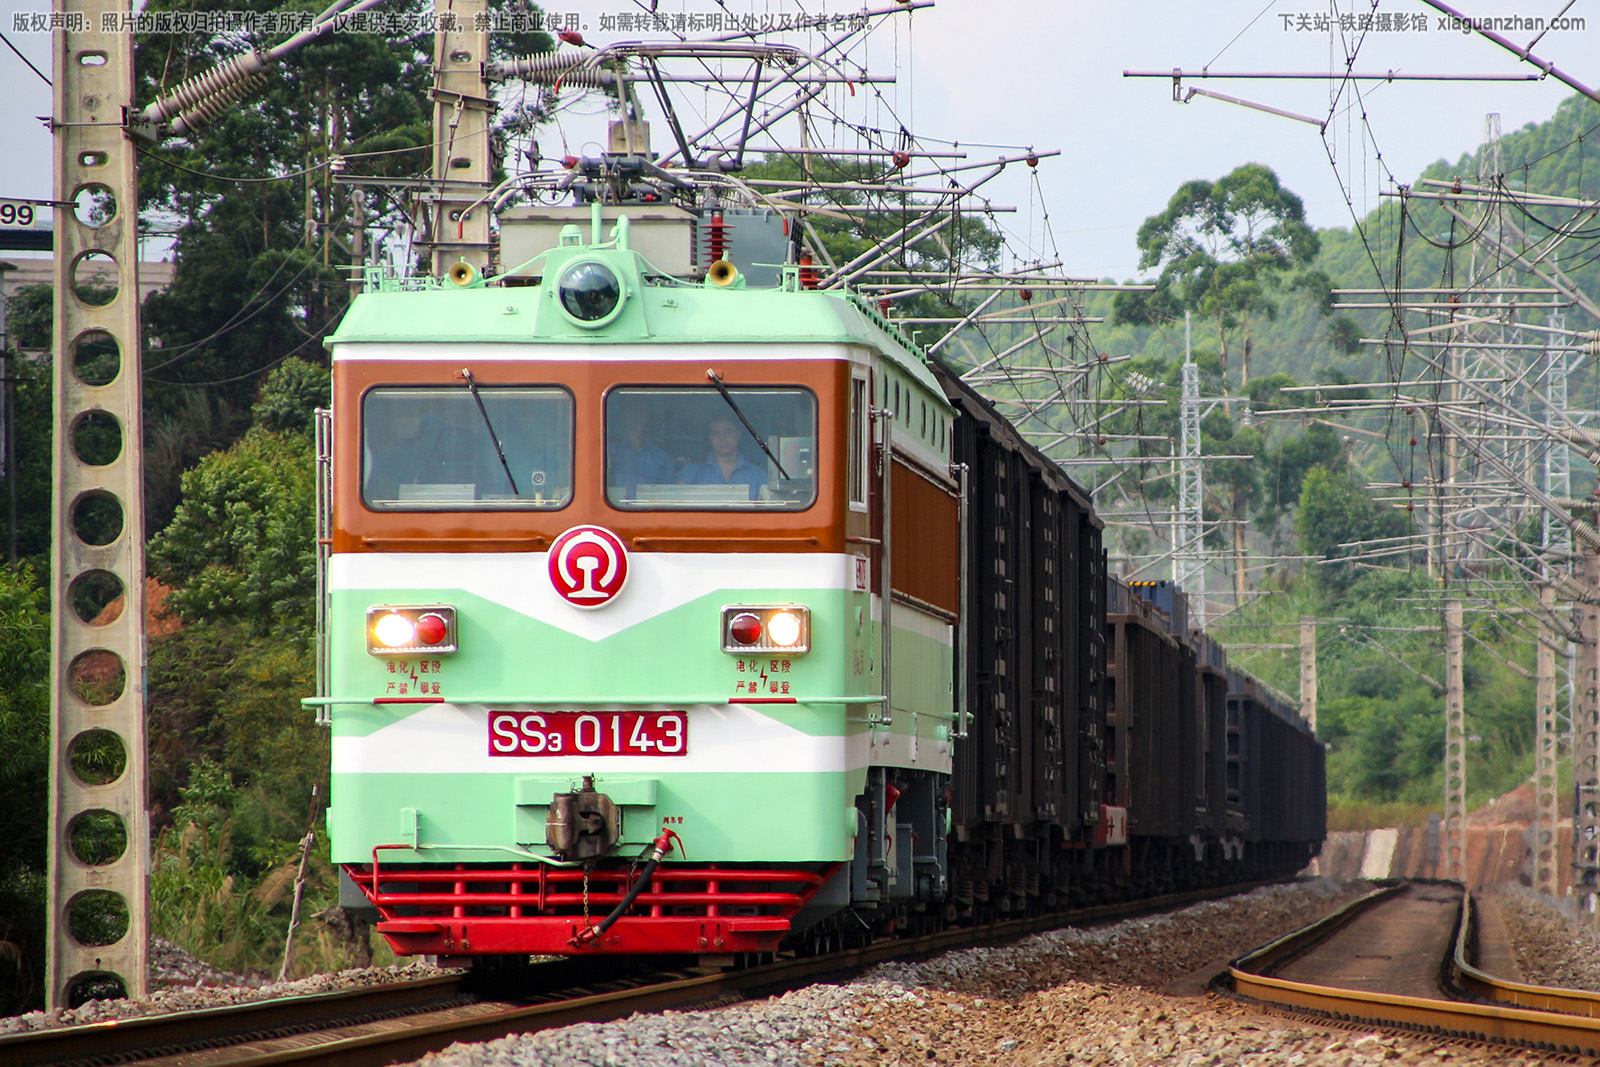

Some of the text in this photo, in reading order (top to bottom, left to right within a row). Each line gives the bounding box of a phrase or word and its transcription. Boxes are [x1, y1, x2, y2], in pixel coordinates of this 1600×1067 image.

[0, 203, 34, 226] 99
[386, 660, 441, 674] 电化区段
[736, 659, 791, 674] 电化区段
[386, 681, 441, 695] 严禁攀登
[735, 680, 791, 695] 严禁攀登
[574, 715, 682, 752] 0143
